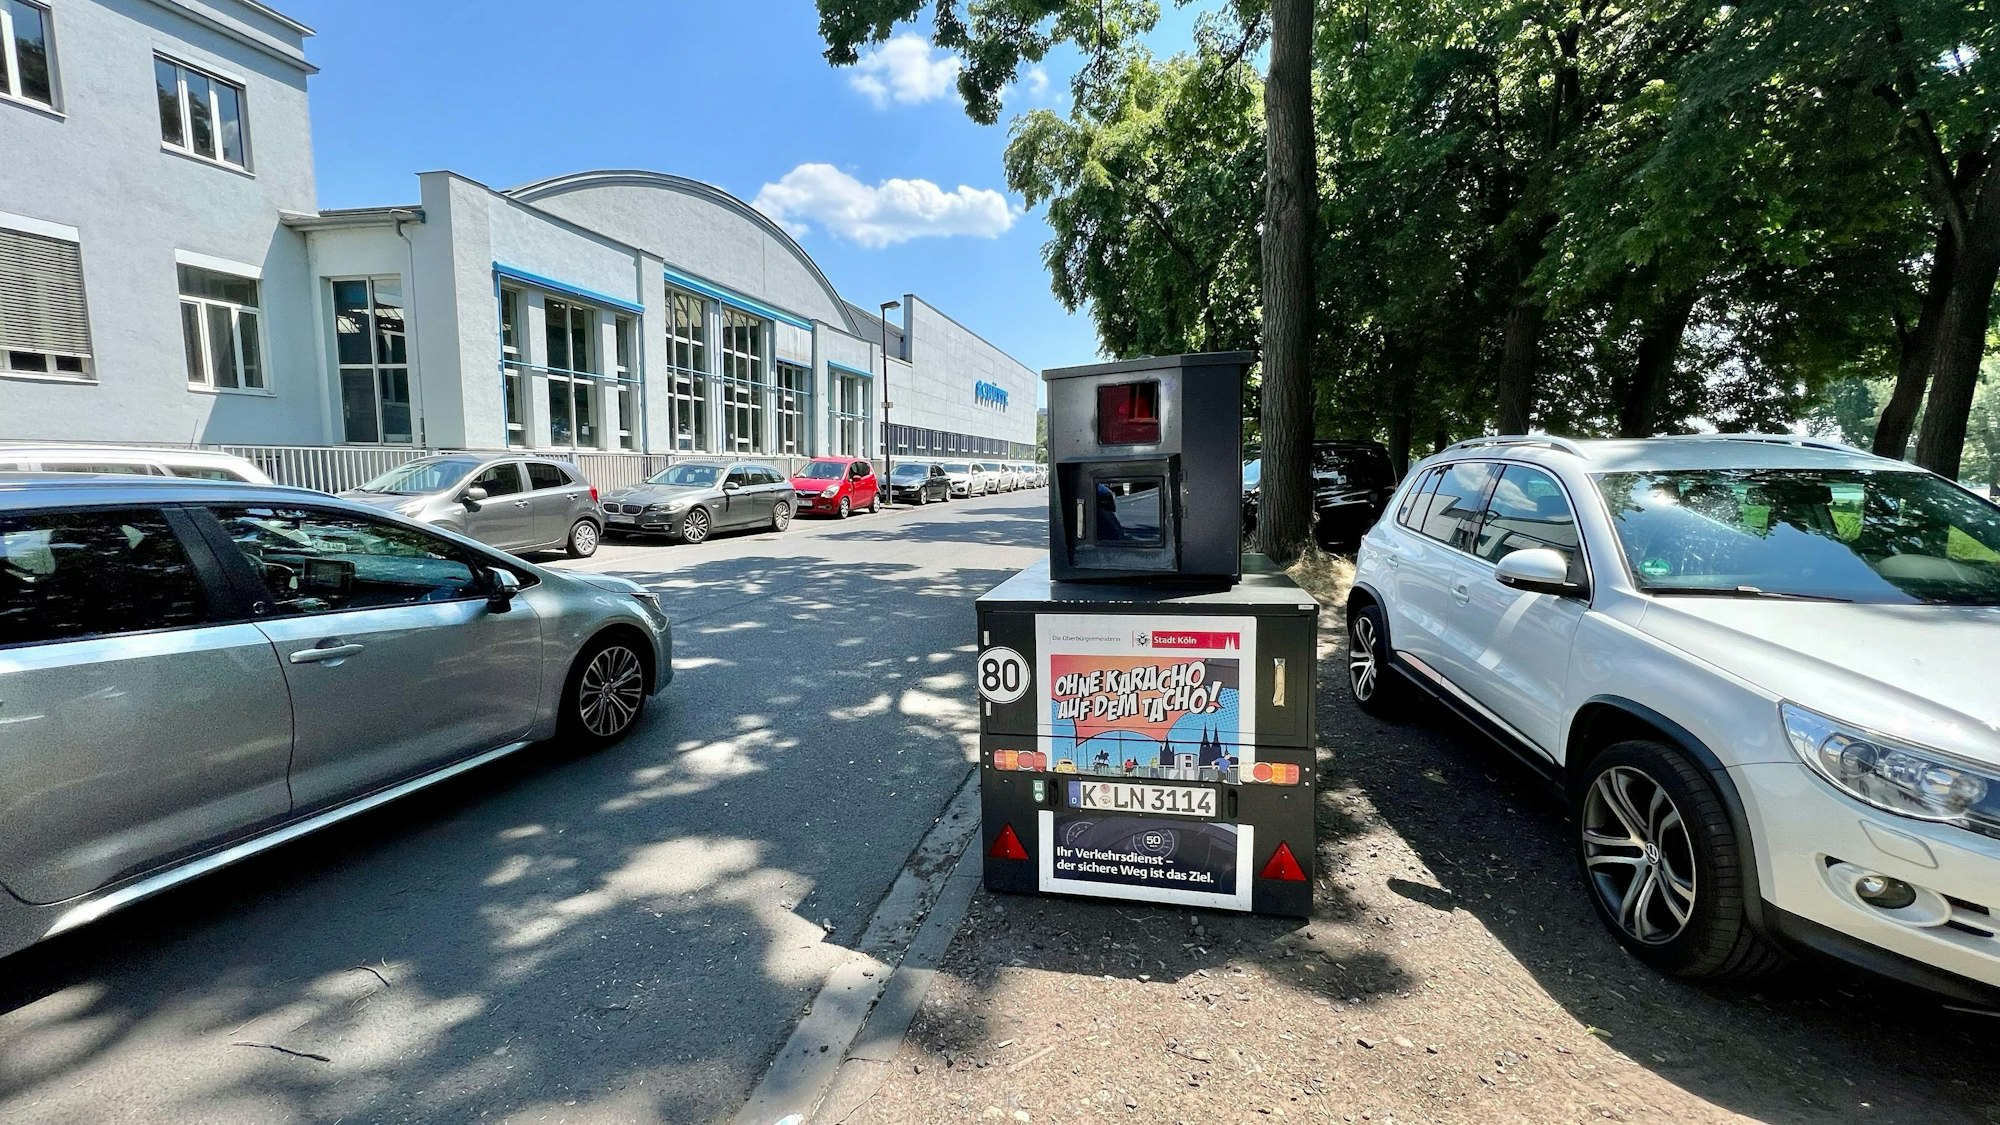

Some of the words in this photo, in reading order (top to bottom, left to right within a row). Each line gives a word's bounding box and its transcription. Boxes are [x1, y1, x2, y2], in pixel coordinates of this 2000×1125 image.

[1062, 635, 1121, 643] Oberbürgermeisterin
[1153, 636, 1177, 644] Stadt
[1177, 636, 1197, 645] Köln
[982, 658, 1020, 693] 80
[1055, 669, 1103, 698] OHNE
[1105, 660, 1206, 697] KARACHO
[1057, 697, 1092, 721] AUF
[1094, 691, 1139, 721] DEM
[1142, 681, 1222, 723] TACHO!
[1114, 786, 1145, 810] LN
[1151, 789, 1212, 814] 3114
[1146, 835, 1161, 845] 50
[1056, 846, 1073, 858] Ihr
[1075, 848, 1164, 865] Verkehrsdienst
[1056, 859, 1076, 871] der
[1078, 861, 1118, 875] sichere
[1120, 865, 1148, 879] Weg
[1150, 867, 1163, 879] ist
[1166, 869, 1187, 881] das
[1188, 871, 1214, 884] Ziel.
